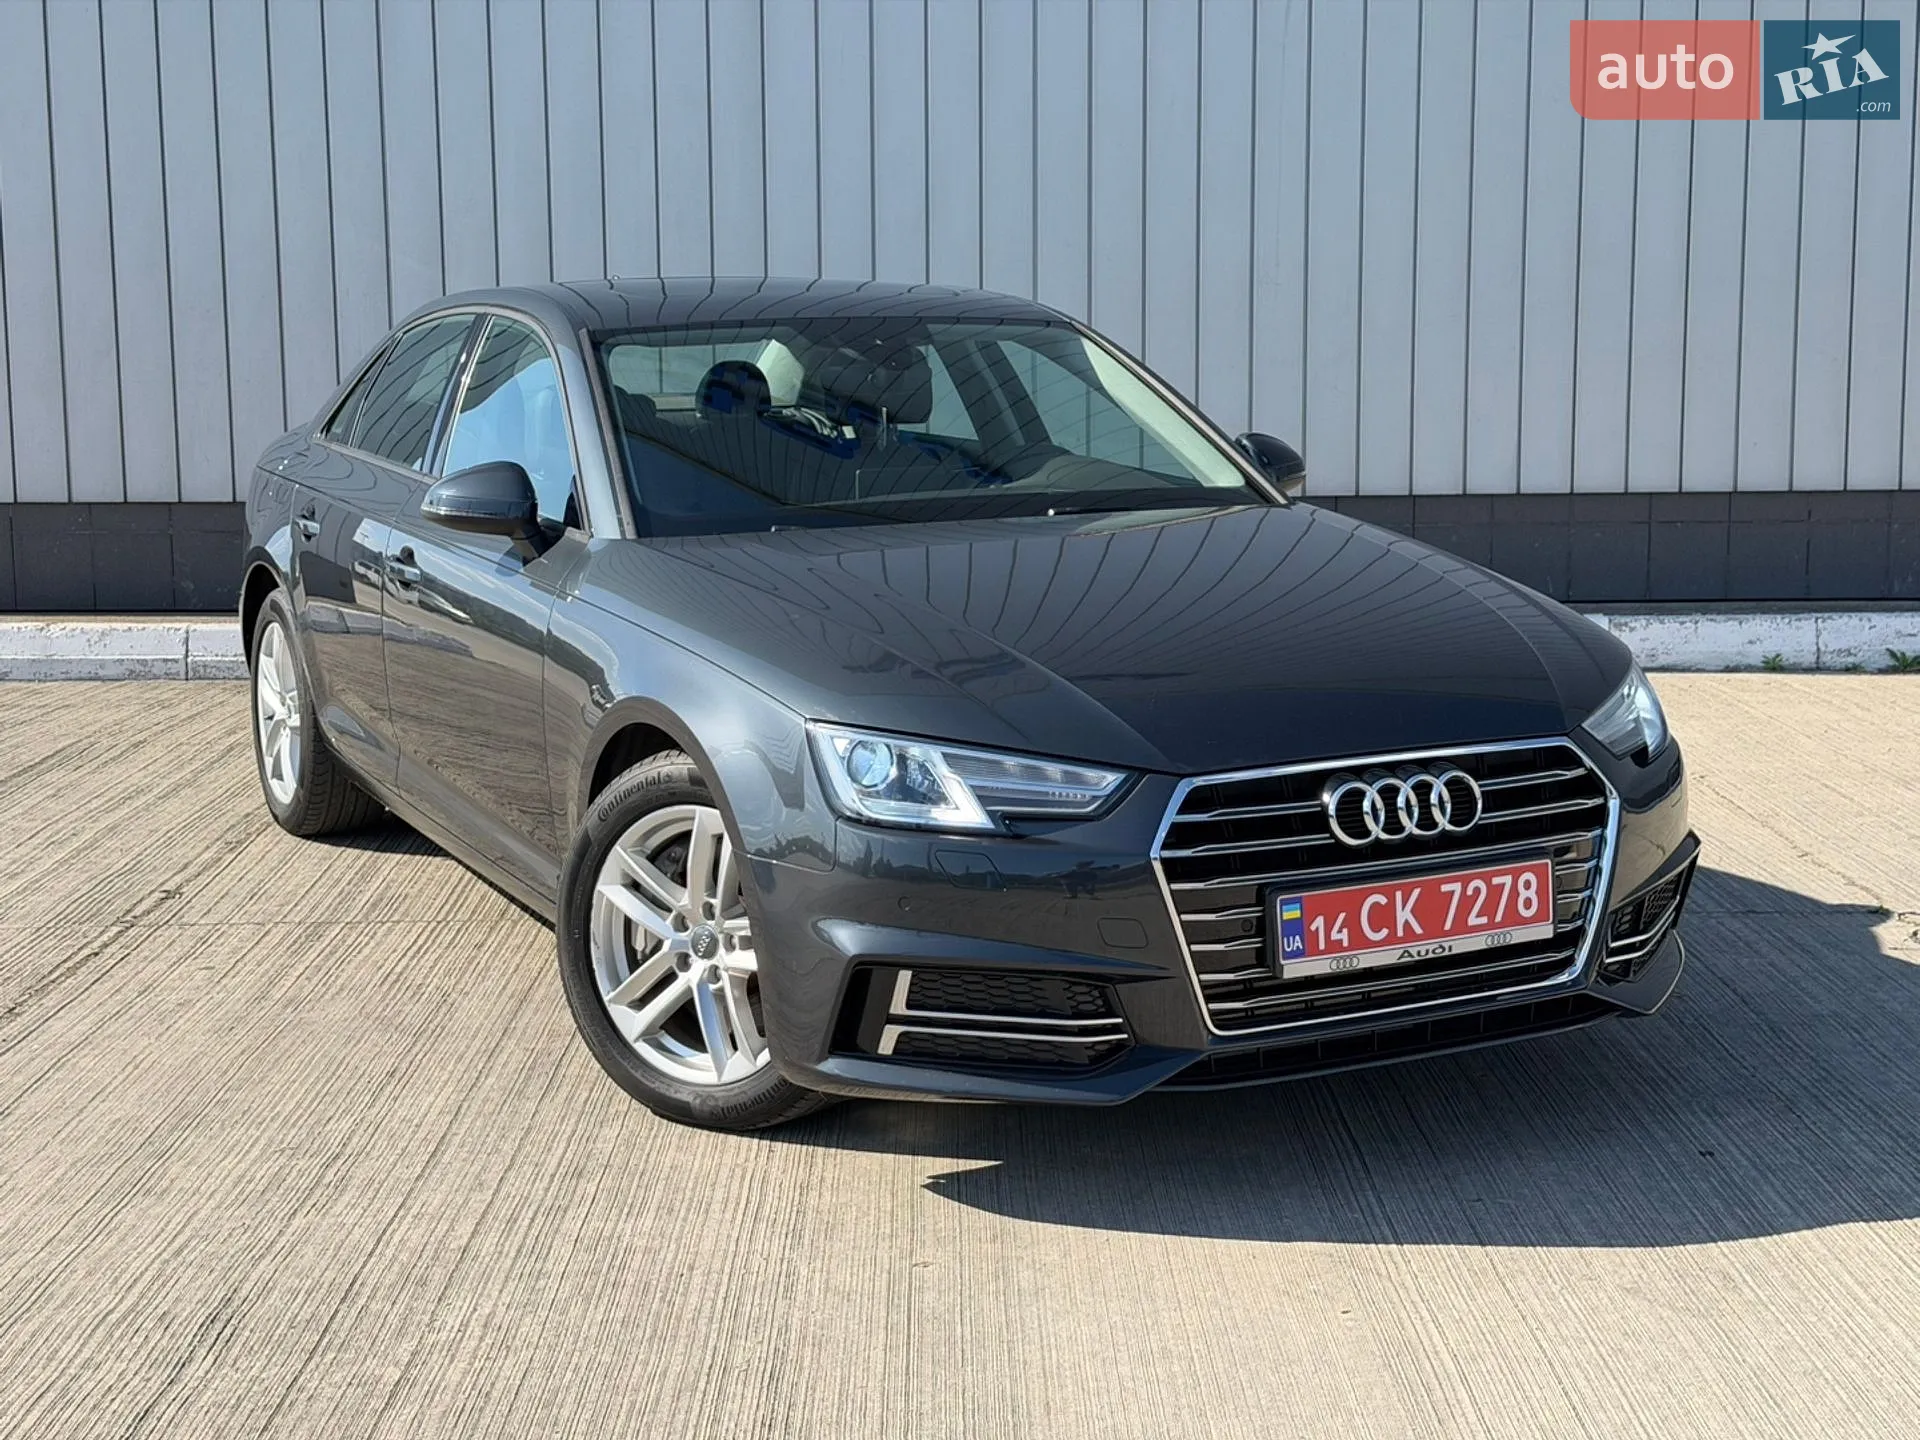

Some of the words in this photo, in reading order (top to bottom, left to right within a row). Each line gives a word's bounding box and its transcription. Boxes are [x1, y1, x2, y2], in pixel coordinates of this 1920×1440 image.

[597, 771, 665, 823] Continental
[1308, 911, 1349, 951] 14
[1359, 887, 1424, 942] CK
[1440, 871, 1539, 932] 7278
[1283, 934, 1303, 952] UA
[1396, 944, 1453, 961] Audi
[720, 1076, 791, 1121] ontinental
